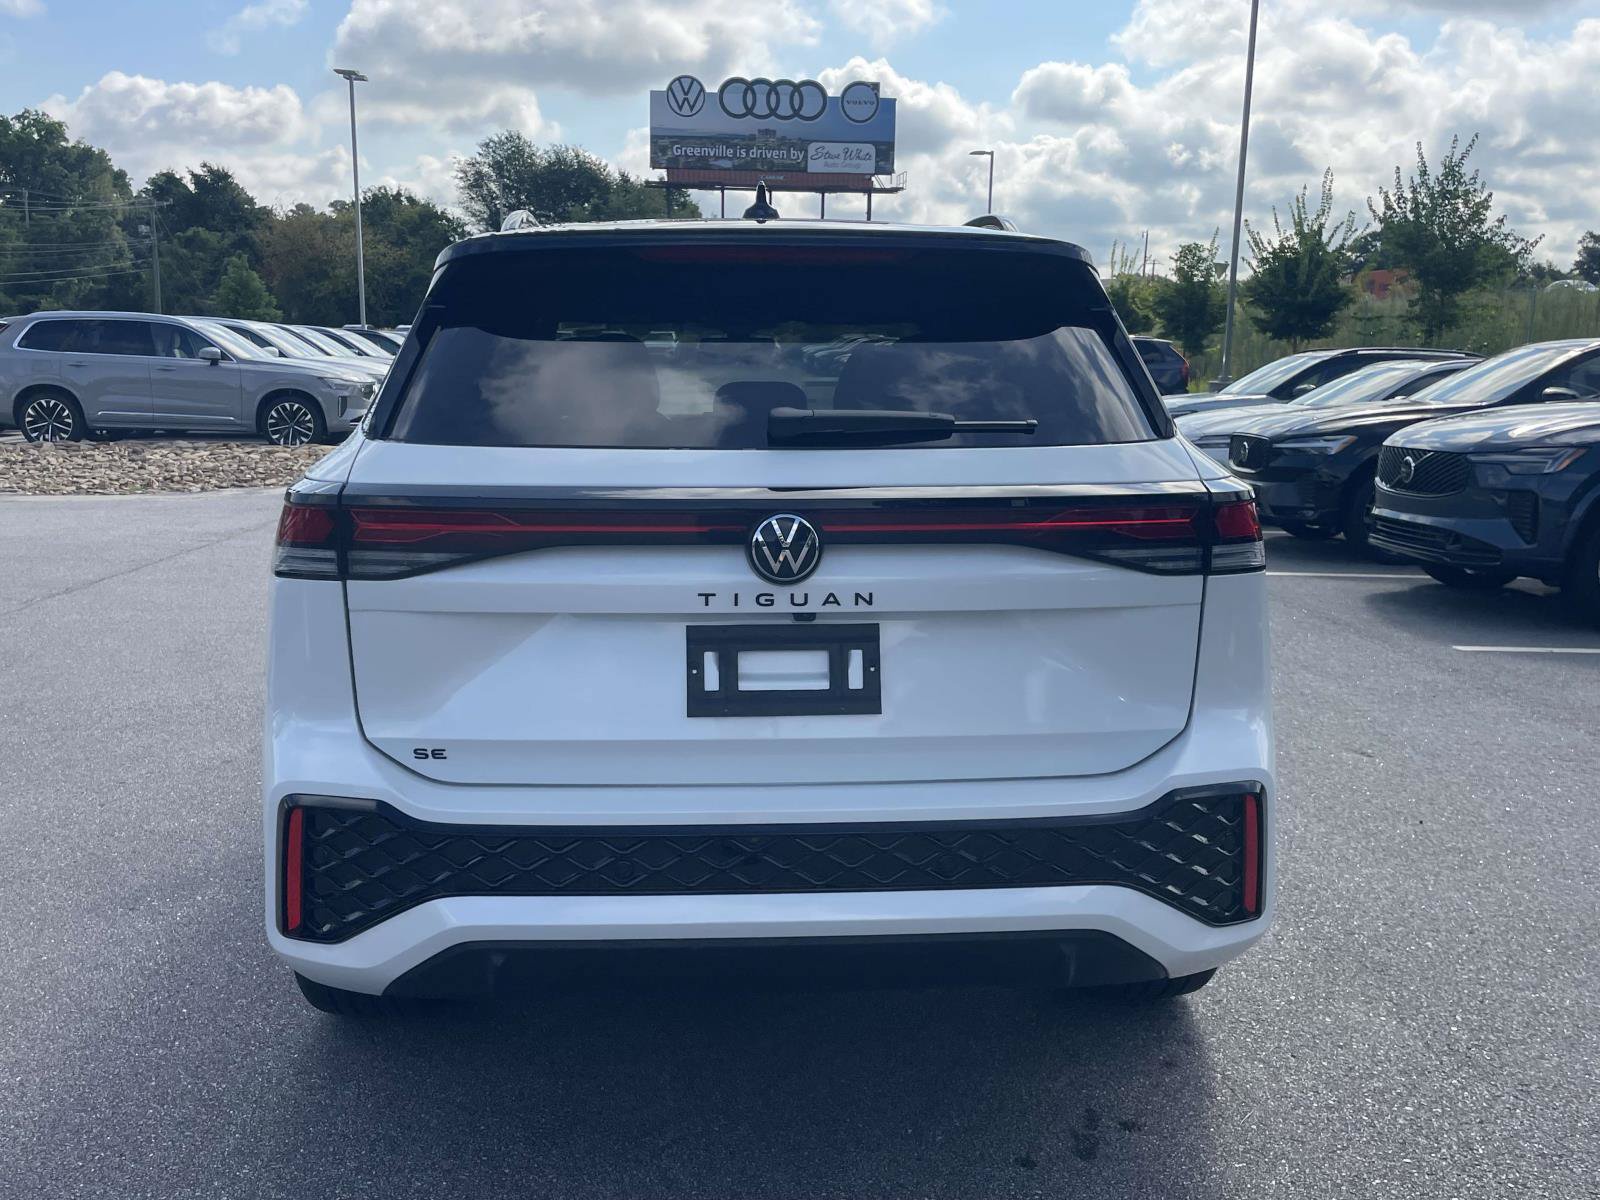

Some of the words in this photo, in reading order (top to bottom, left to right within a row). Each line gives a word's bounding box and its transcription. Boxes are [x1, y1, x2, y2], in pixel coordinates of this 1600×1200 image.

[672, 144, 734, 157] Greenville
[736, 146, 747, 158] is
[749, 147, 787, 159] driven
[790, 147, 805, 161] by
[698, 592, 874, 607] TIGUAN
[413, 748, 447, 759] SE
